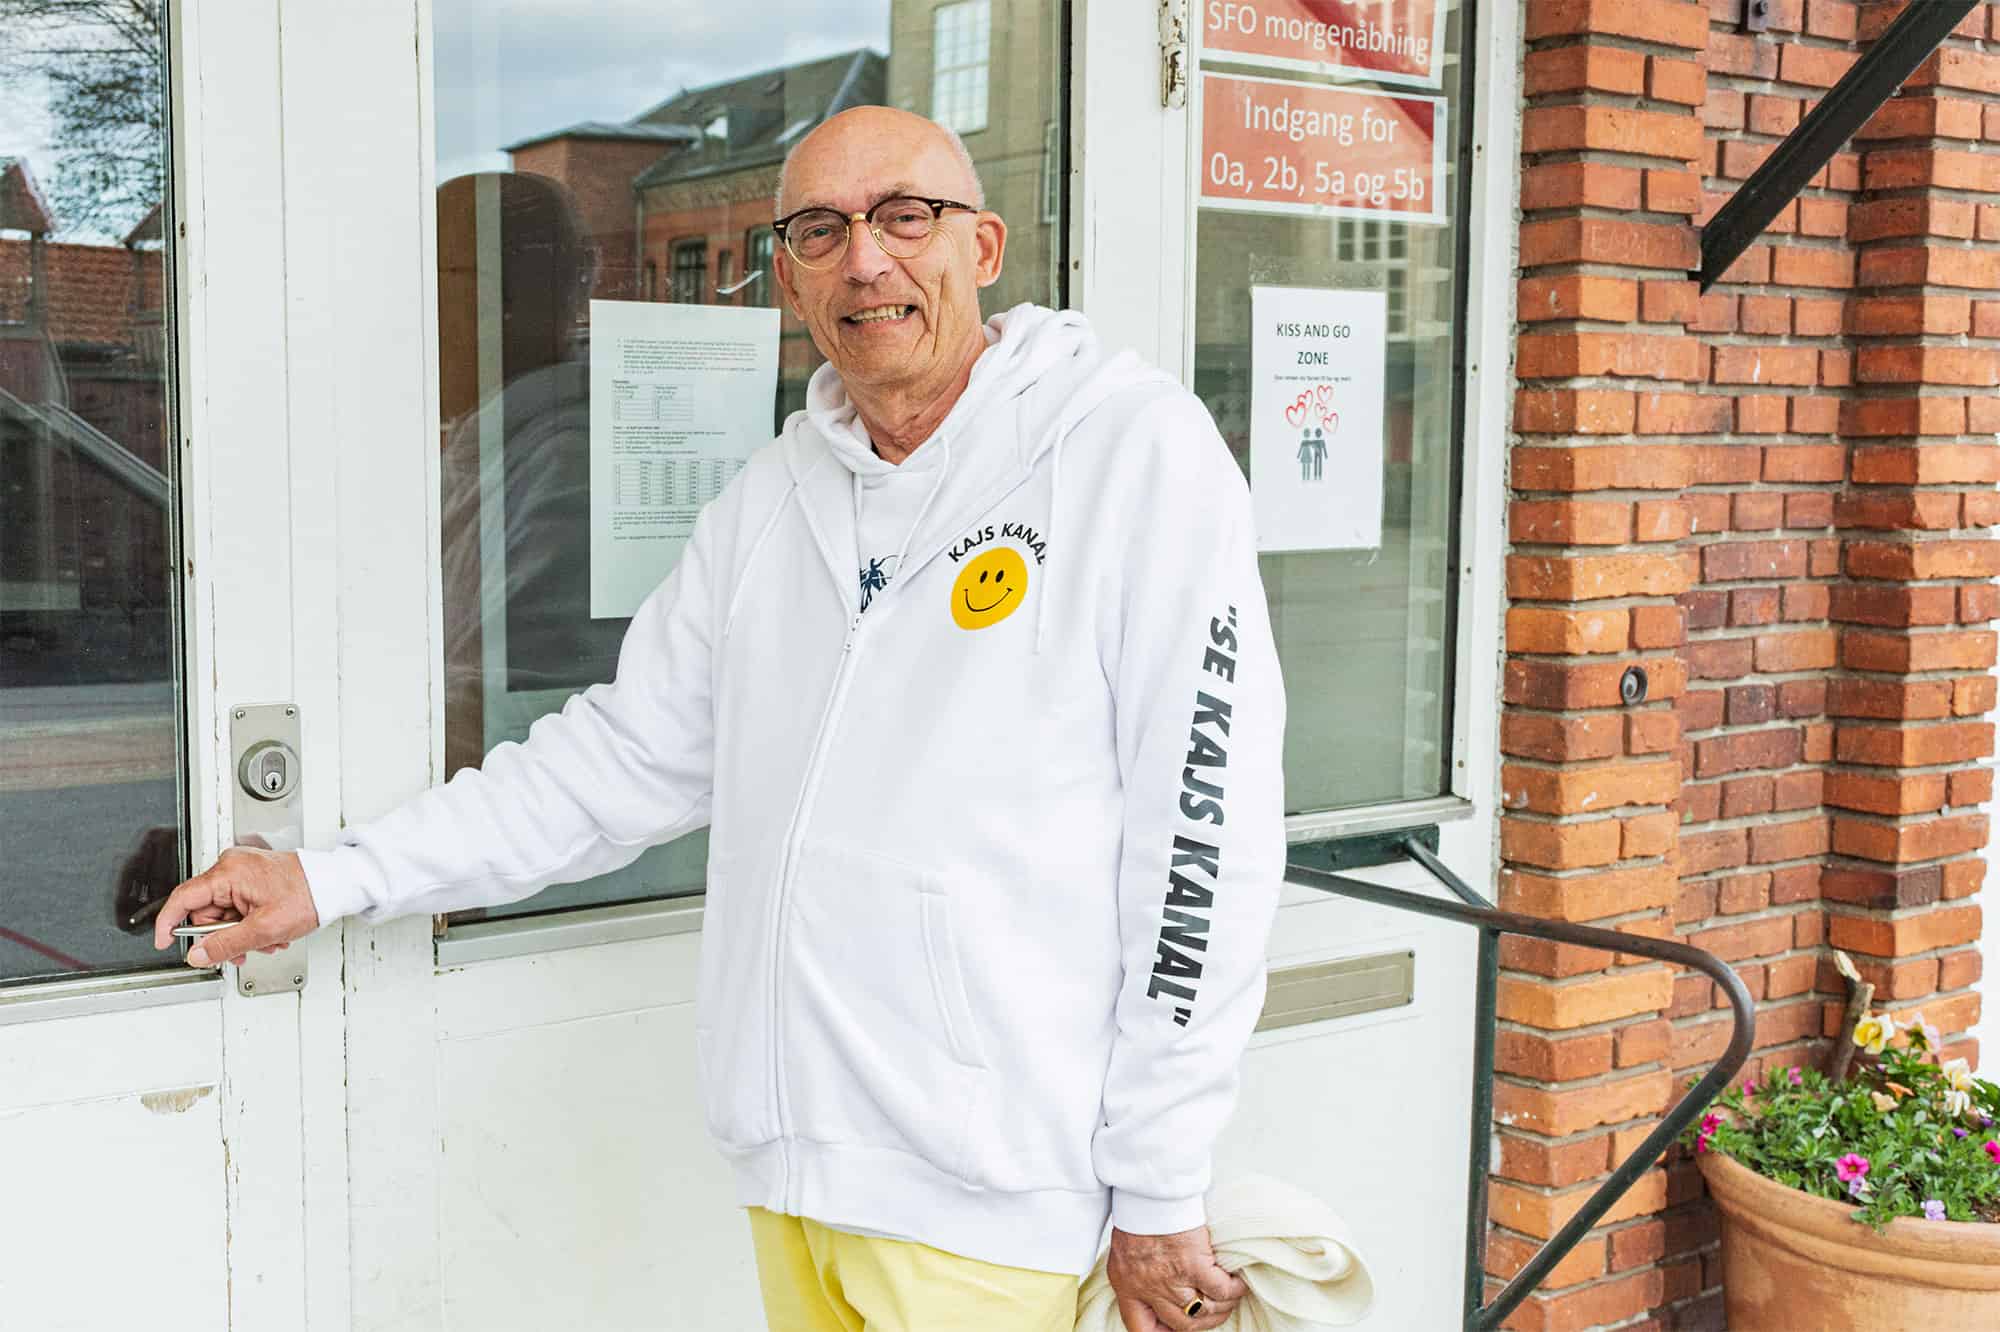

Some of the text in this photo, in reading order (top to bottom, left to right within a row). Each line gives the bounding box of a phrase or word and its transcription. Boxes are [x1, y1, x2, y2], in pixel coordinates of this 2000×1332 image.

[1208, 2, 1428, 64] SFO morgenåbning
[1244, 96, 1399, 145] Indgang for
[1211, 152, 1424, 205] 0a, 2b, 5a og 5b
[1276, 323, 1351, 339] KISS AND GO
[1297, 352, 1329, 365] ZONE
[948, 526, 995, 563] KAJS
[1147, 605, 1238, 1028] "SE KAJS KANAL"
